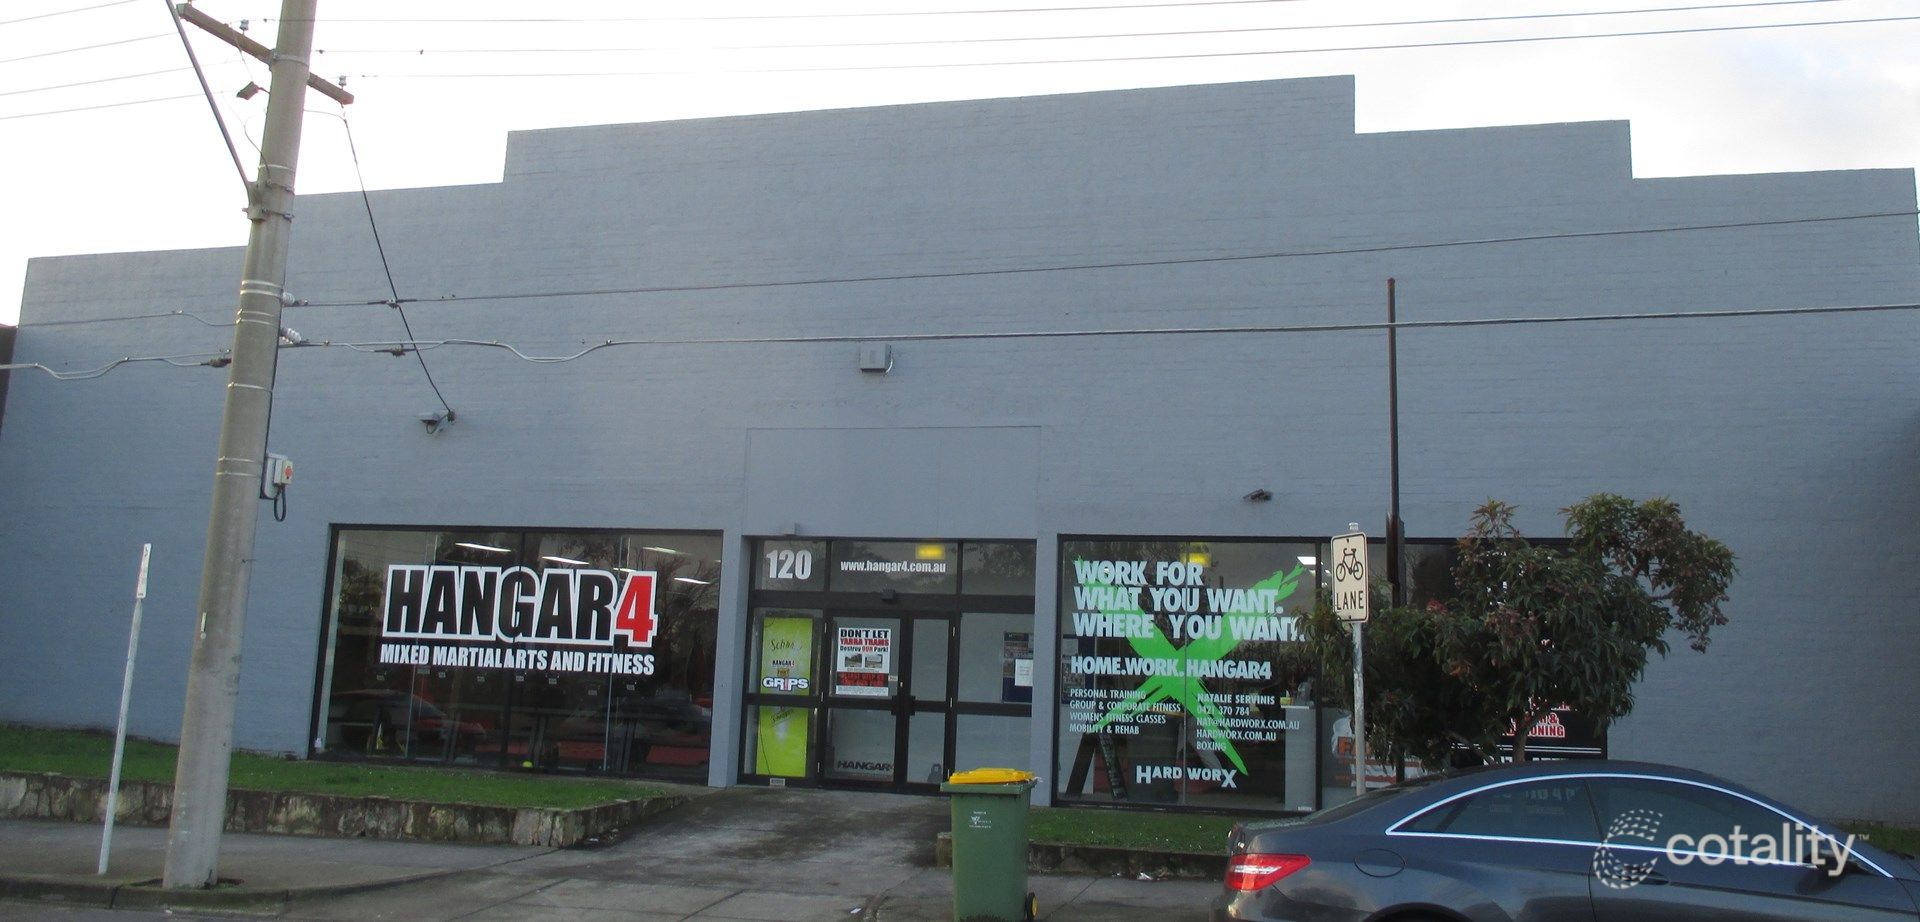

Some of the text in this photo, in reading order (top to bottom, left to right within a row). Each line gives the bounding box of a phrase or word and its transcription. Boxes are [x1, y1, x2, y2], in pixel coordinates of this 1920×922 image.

[765, 549, 812, 580] 120
[840, 560, 946, 573] www.hangar4.com.au
[1073, 560, 1204, 586] WORK FOR
[382, 564, 658, 648] HANGAR4
[1073, 586, 1284, 614] WHAT YOU WANT.
[1336, 590, 1364, 611] LANE
[1072, 612, 1154, 639] WHERE
[1168, 614, 1222, 640] YOU
[840, 629, 890, 639] DON'T LET
[840, 638, 890, 647] YARRA TRAMS
[380, 643, 655, 676] MIXED MARTIAL ARTS AND FITNESS
[1070, 655, 1272, 680] HOME.WORK.HANGAR4
[762, 677, 810, 692] GRIPS
[1069, 688, 1147, 700] PERSONAL TRAINING
[1197, 693, 1275, 705] NATALIE SERVINIS
[1069, 700, 1181, 713] GROUP & CORPORATE FITNESS
[1197, 705, 1250, 716] 0421 370 784
[1069, 711, 1167, 724] WOMENS FITNESS CLASSES
[1197, 717, 1300, 730] NAT@HARDWORX.COM.AU
[1069, 723, 1140, 735] MOBILITY & REHAB
[1196, 729, 1277, 741] HARDWORX.COM.AU
[1196, 741, 1227, 752] BOXING
